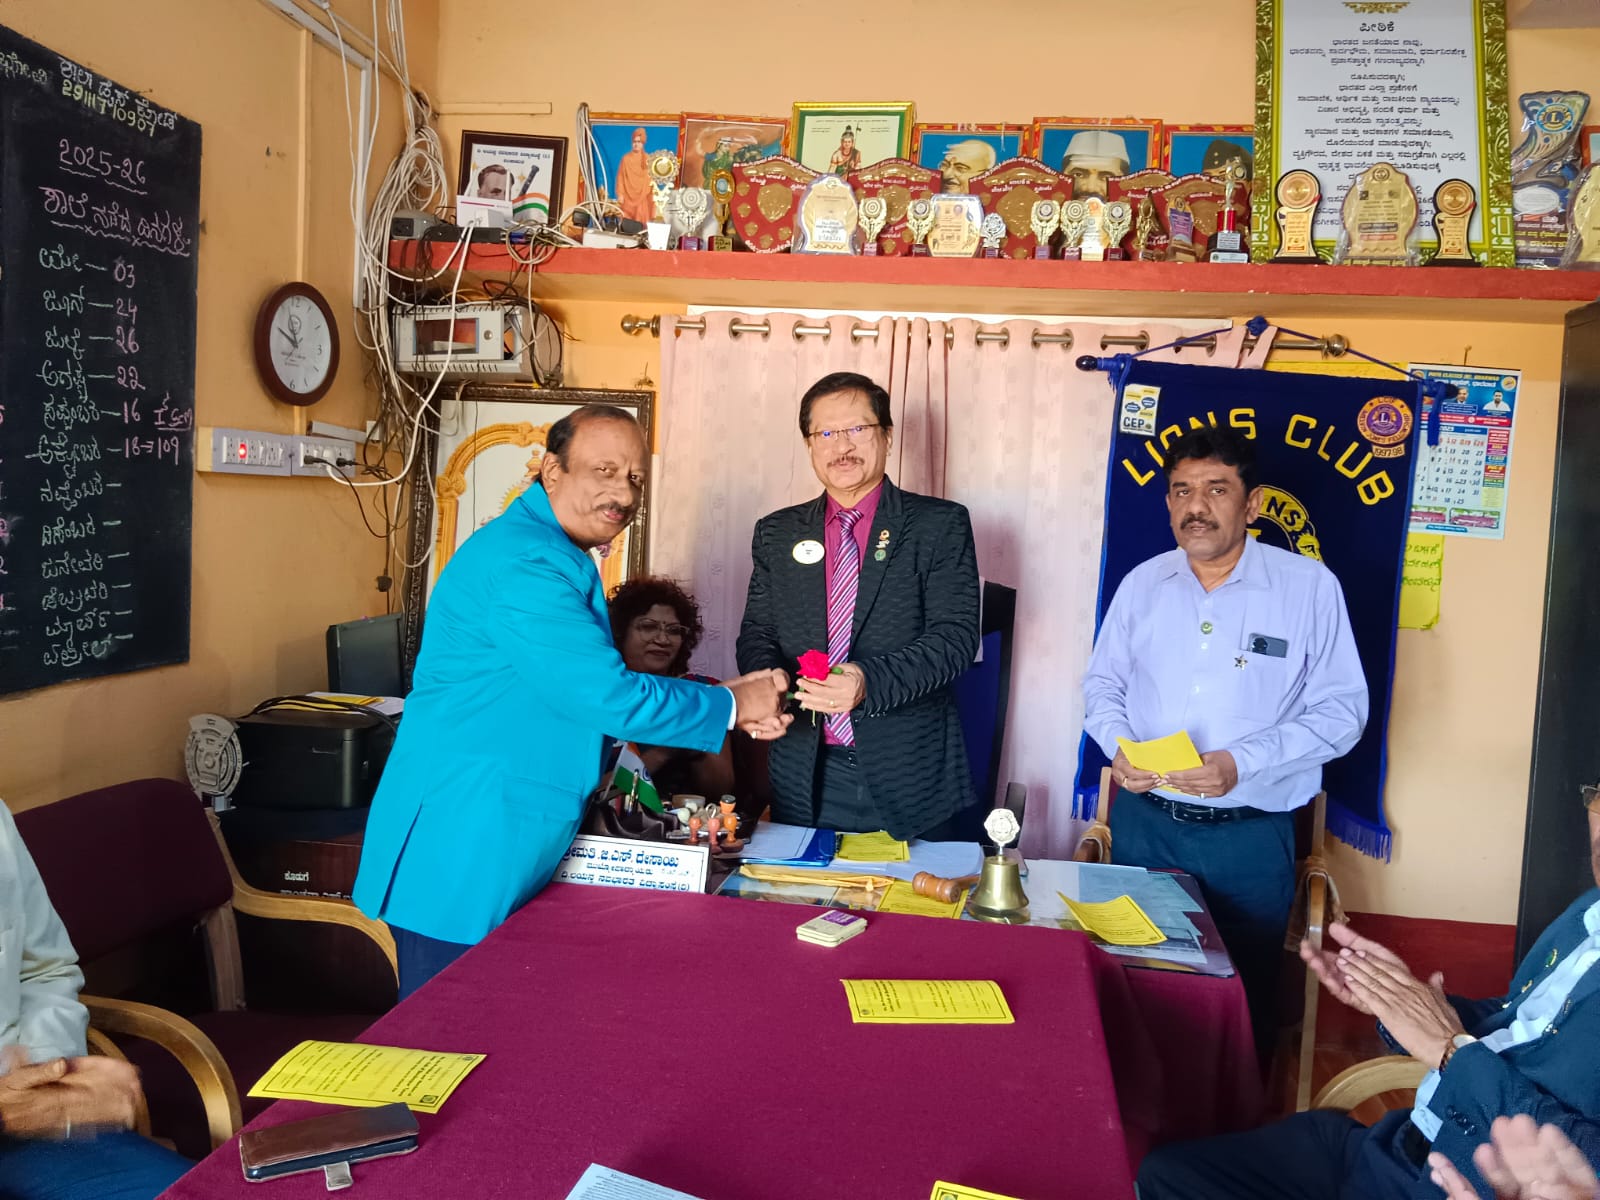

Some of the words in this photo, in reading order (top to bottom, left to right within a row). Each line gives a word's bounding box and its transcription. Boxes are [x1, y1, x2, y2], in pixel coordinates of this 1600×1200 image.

[58, 138, 147, 185] 2025-26
[114, 263, 136, 288] 03
[116, 298, 138, 325] 24
[115, 326, 140, 354] 26
[117, 366, 146, 390] 22
[123, 398, 141, 424] 16
[1123, 416, 1145, 429] CEP
[1284, 414, 1395, 506] CLUB
